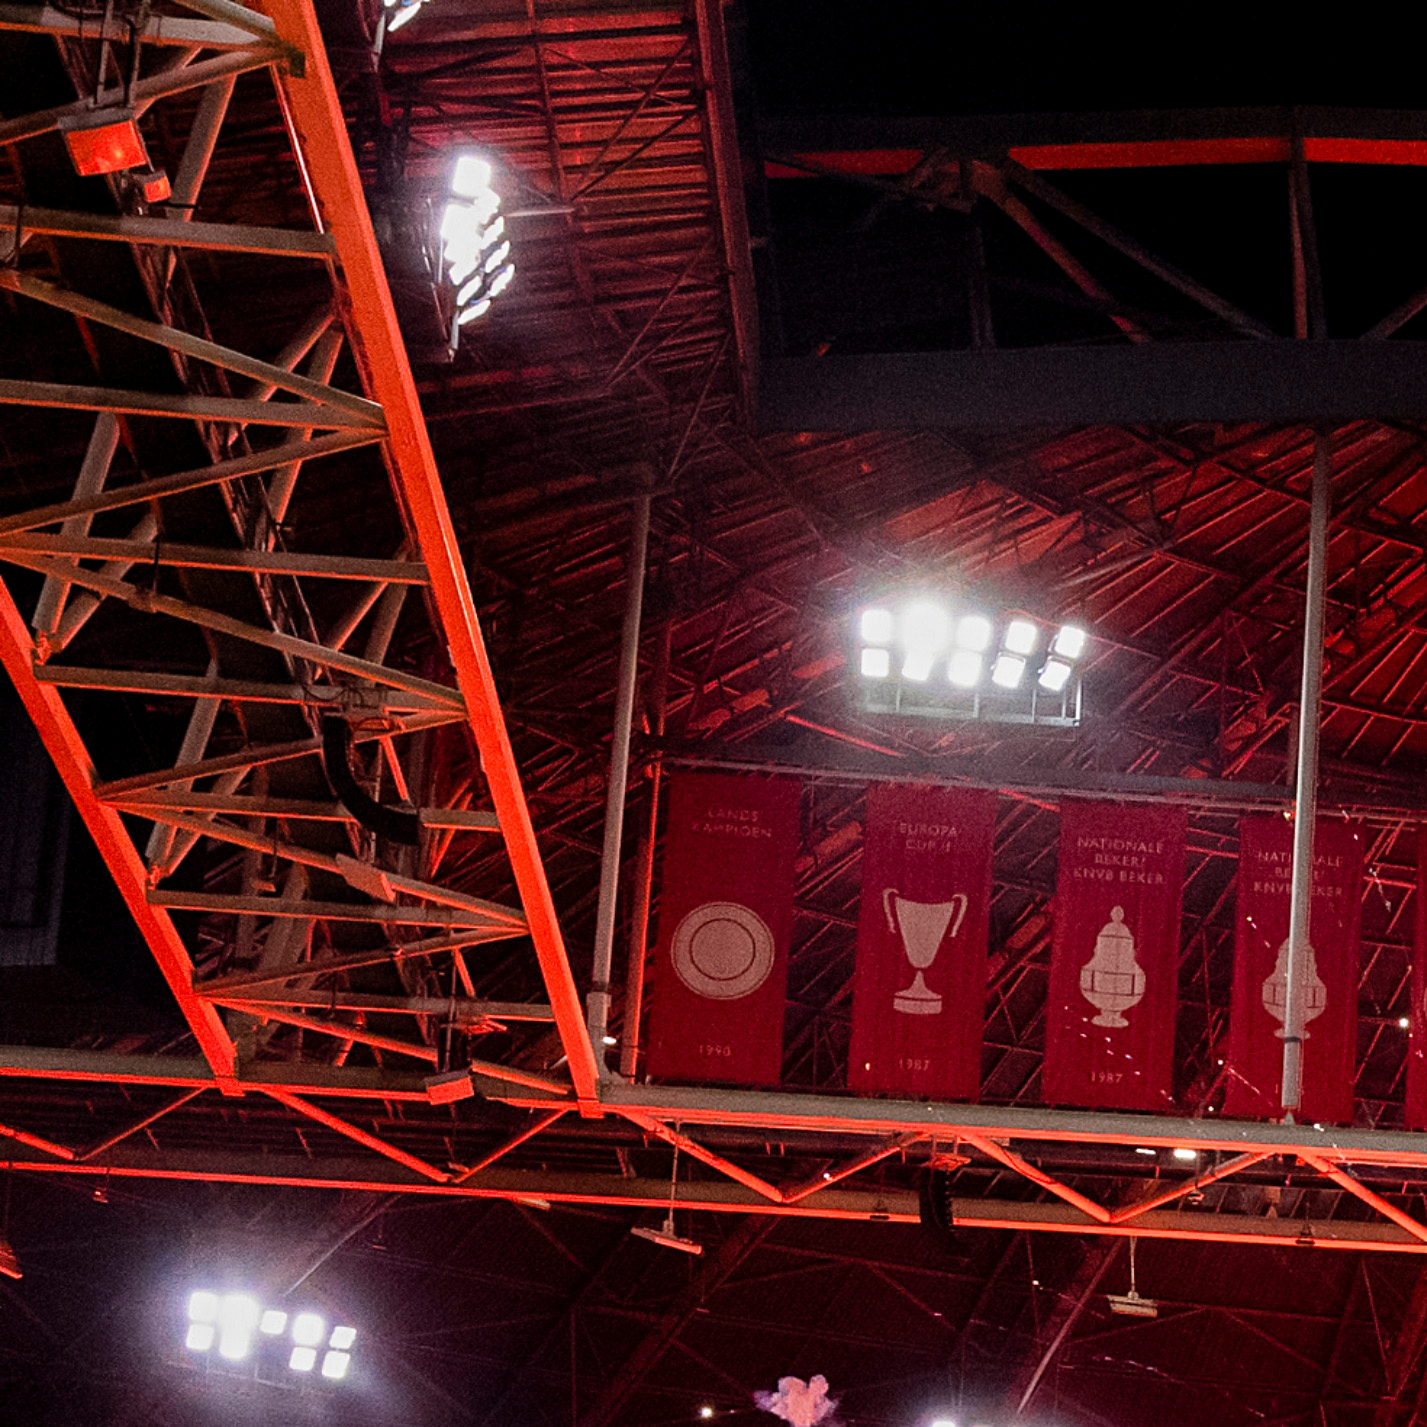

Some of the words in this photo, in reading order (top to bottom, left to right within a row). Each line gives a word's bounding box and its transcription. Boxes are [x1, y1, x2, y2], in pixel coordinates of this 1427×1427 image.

[1077, 836, 1163, 853] NATIONALE
[1072, 867, 1114, 881] KNVB
[1119, 870, 1164, 884] BEKER
[1090, 1071, 1124, 1084] 1987
